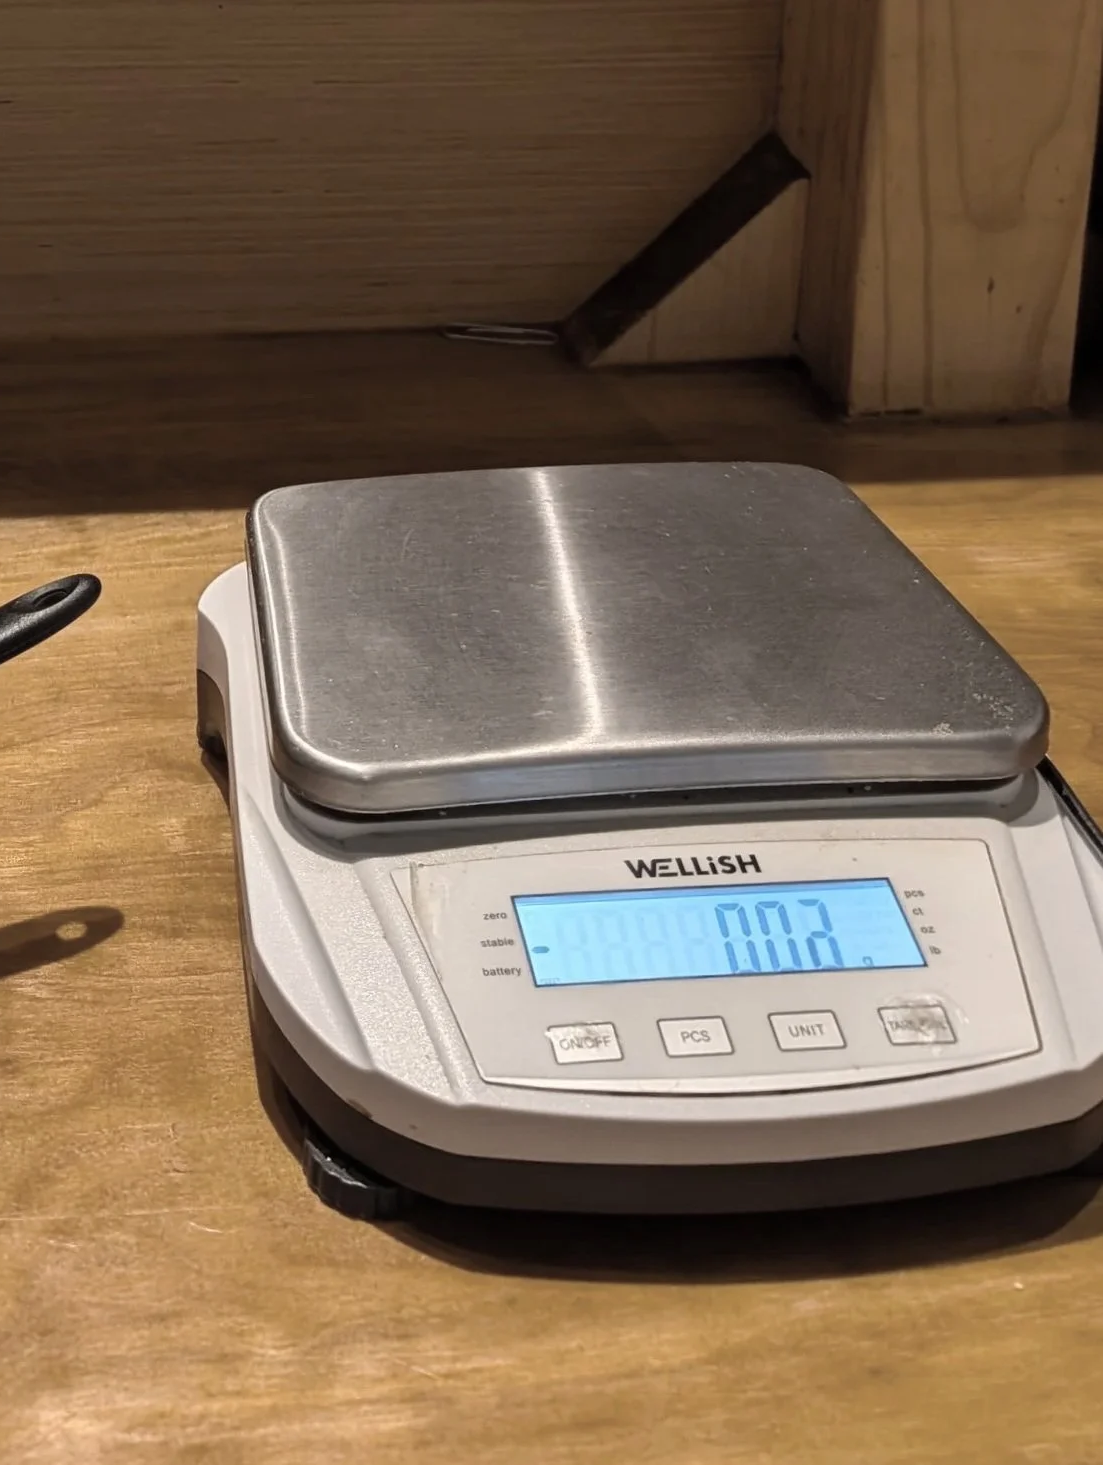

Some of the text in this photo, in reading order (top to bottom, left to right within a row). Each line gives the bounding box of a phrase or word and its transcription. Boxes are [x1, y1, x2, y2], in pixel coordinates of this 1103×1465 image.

[904, 889, 924, 898] pcs
[483, 911, 507, 920] zero
[913, 907, 923, 916] ct
[920, 926, 934, 934] oz
[480, 937, 514, 948] stable
[930, 946, 940, 955] lb
[482, 966, 521, 978] battery
[788, 1024, 824, 1038] UNIT
[680, 1030, 710, 1043] PCS
[559, 1036, 611, 1050] ON/OFF
